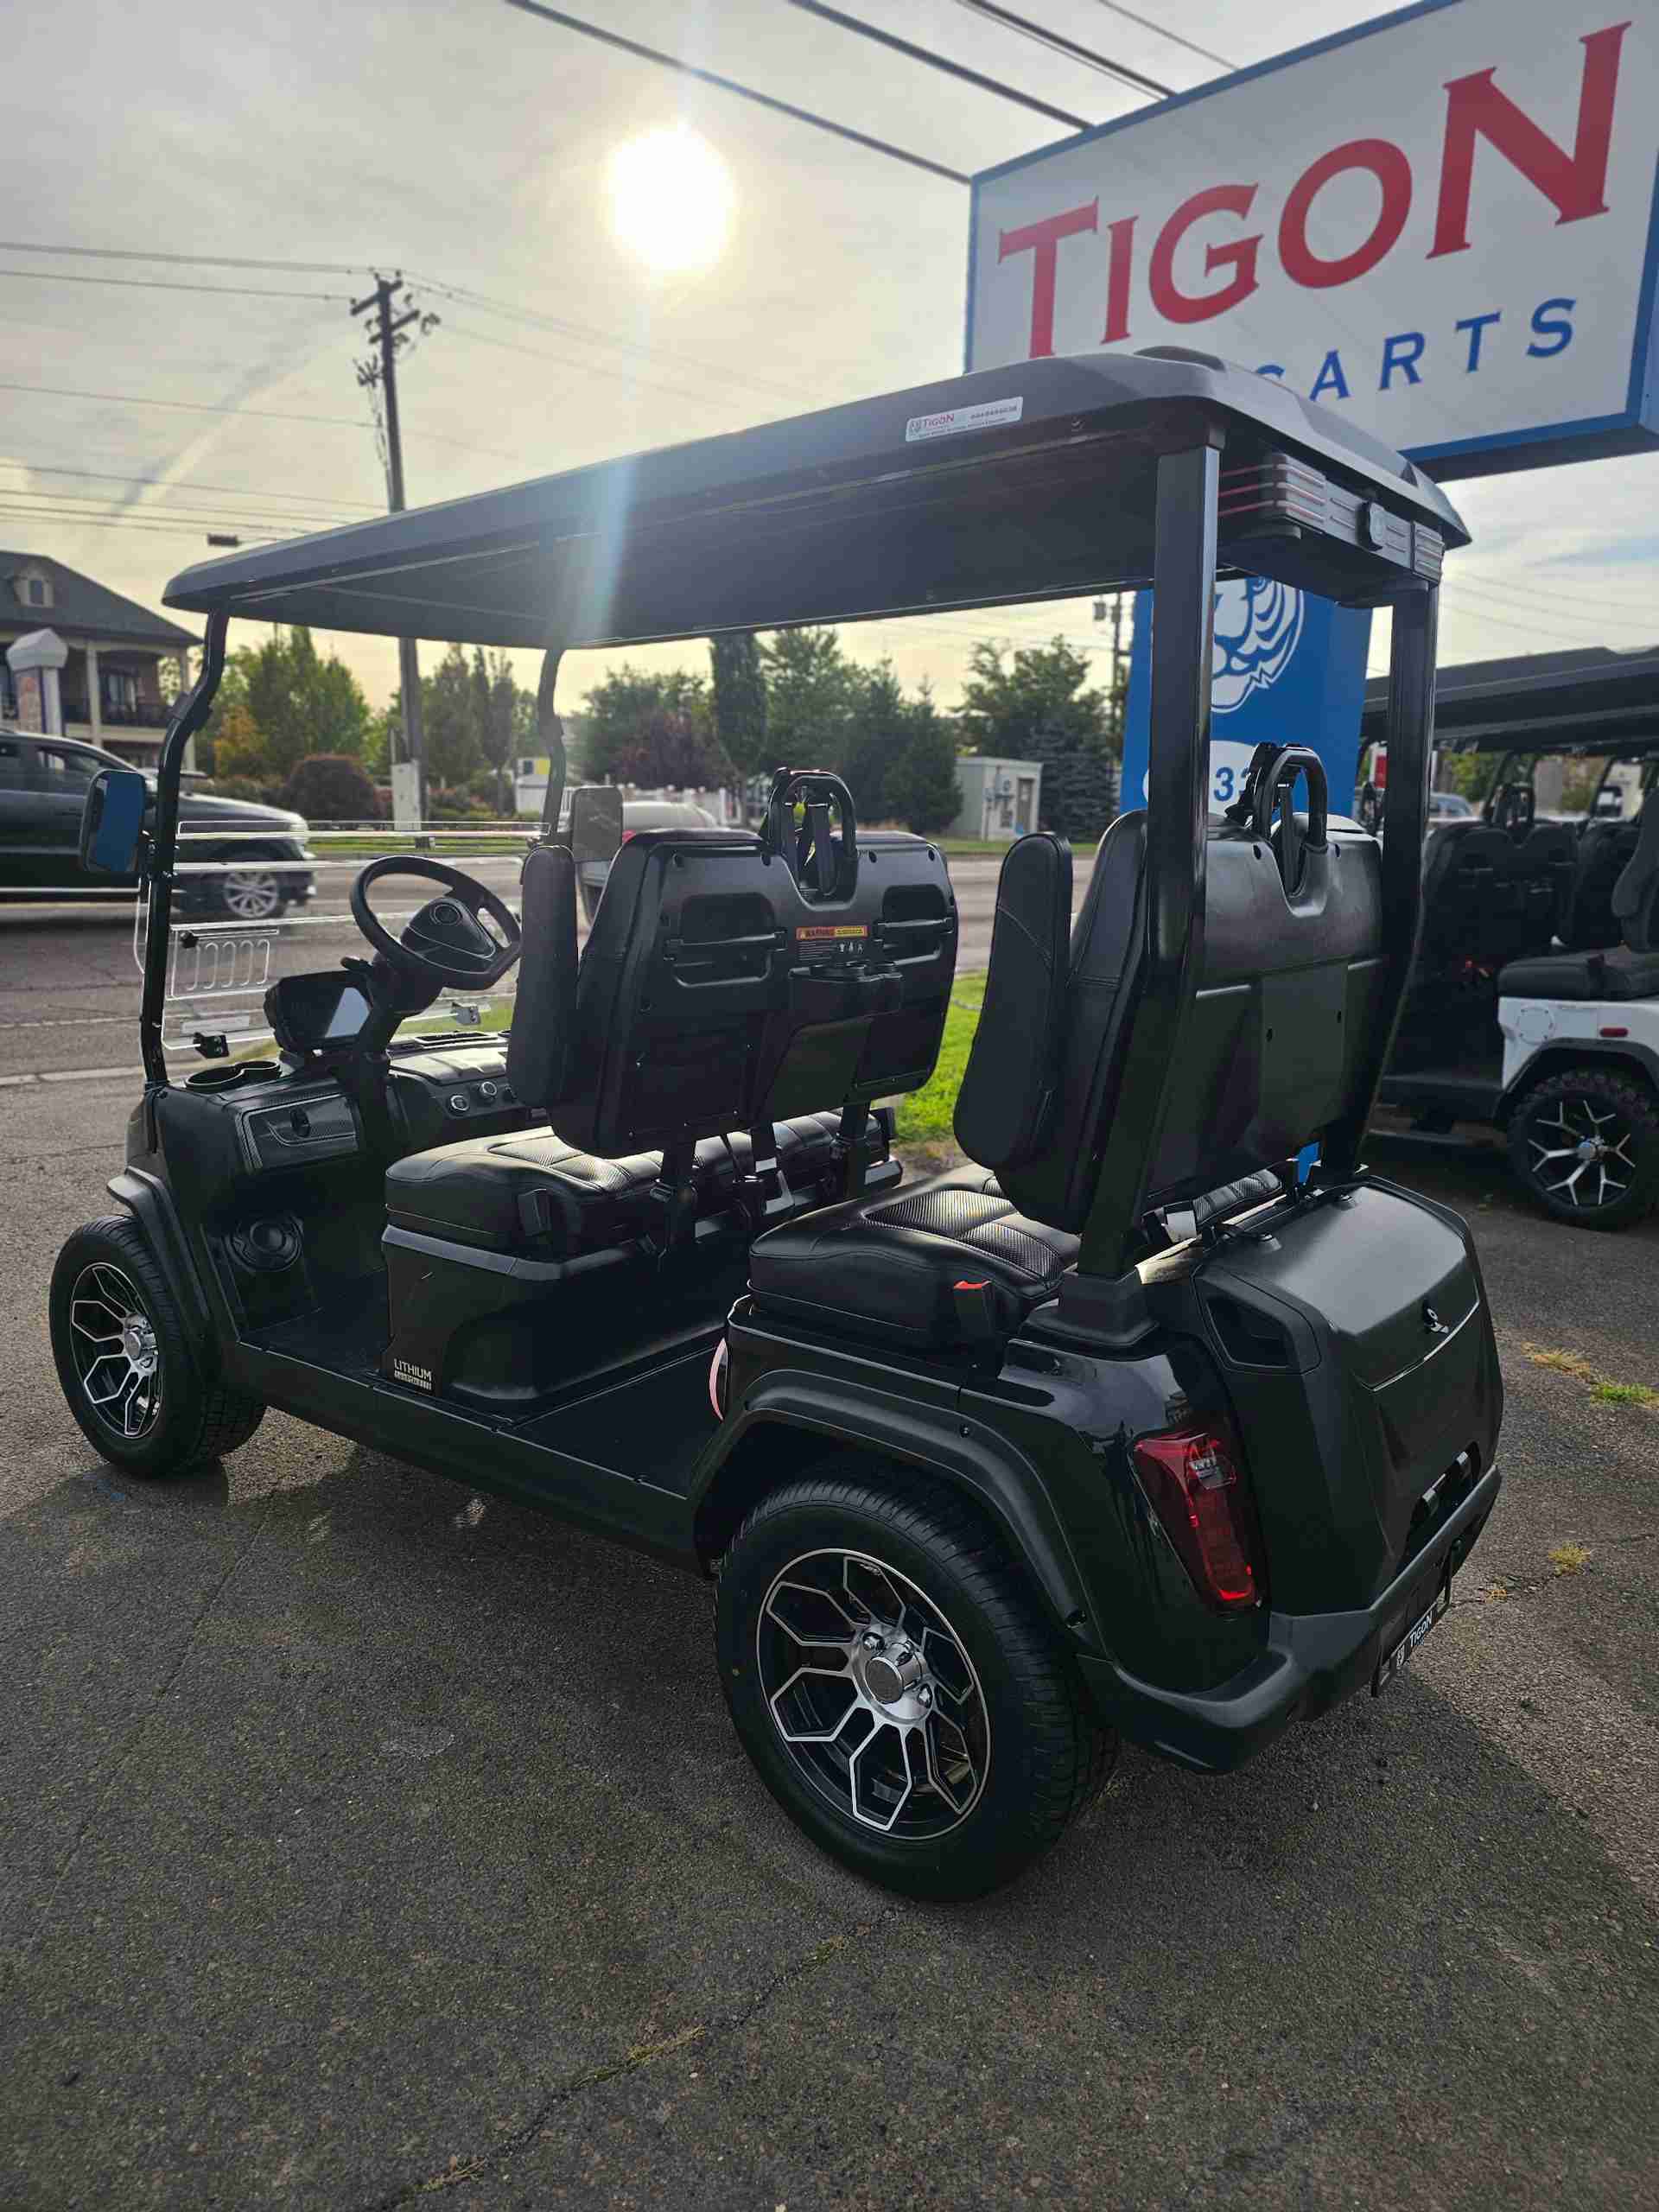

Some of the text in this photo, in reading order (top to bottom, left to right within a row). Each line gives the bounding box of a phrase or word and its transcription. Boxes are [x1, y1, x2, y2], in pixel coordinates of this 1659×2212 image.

[997, 21, 1632, 358] TIGON
[1257, 297, 1577, 402] ARTS
[925, 413, 954, 428] TIGON
[393, 1357, 432, 1382] LITHIUM
[1409, 1610, 1433, 1647] TIGON
